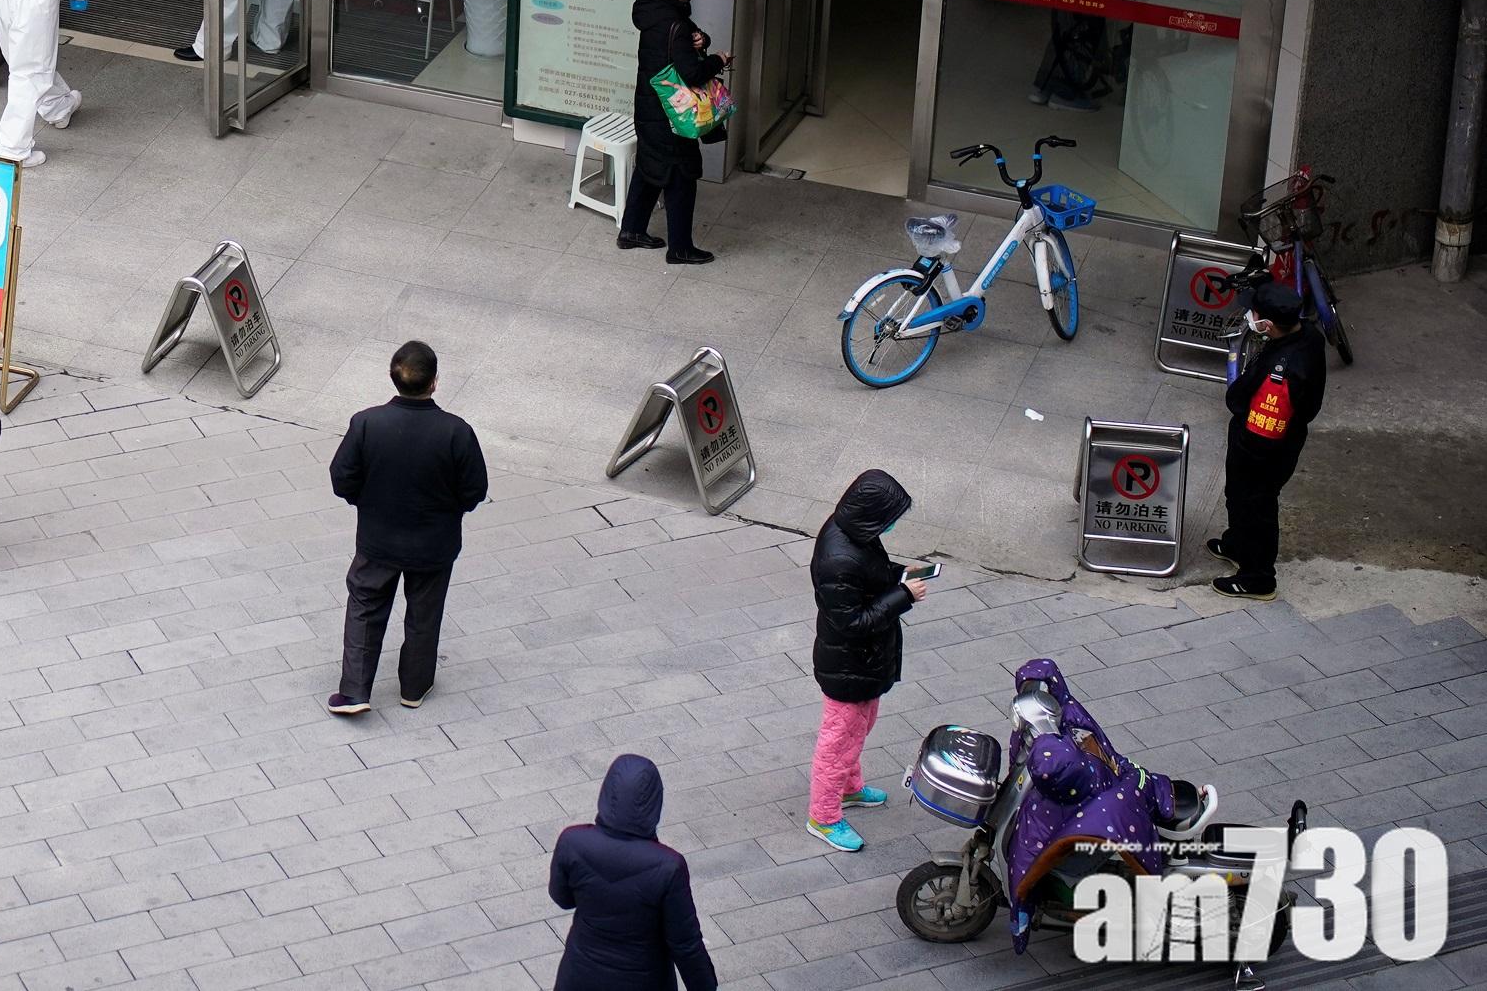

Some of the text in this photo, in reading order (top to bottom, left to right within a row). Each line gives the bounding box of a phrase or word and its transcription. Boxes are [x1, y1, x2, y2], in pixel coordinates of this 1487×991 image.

[230, 311, 262, 348] 请勿泊车
[700, 424, 738, 461] 请勿泊车
[704, 440, 742, 475] NO PARKING
[1094, 519, 1167, 535] NO PARKING
[1095, 500, 1169, 519] 请勿泊车
